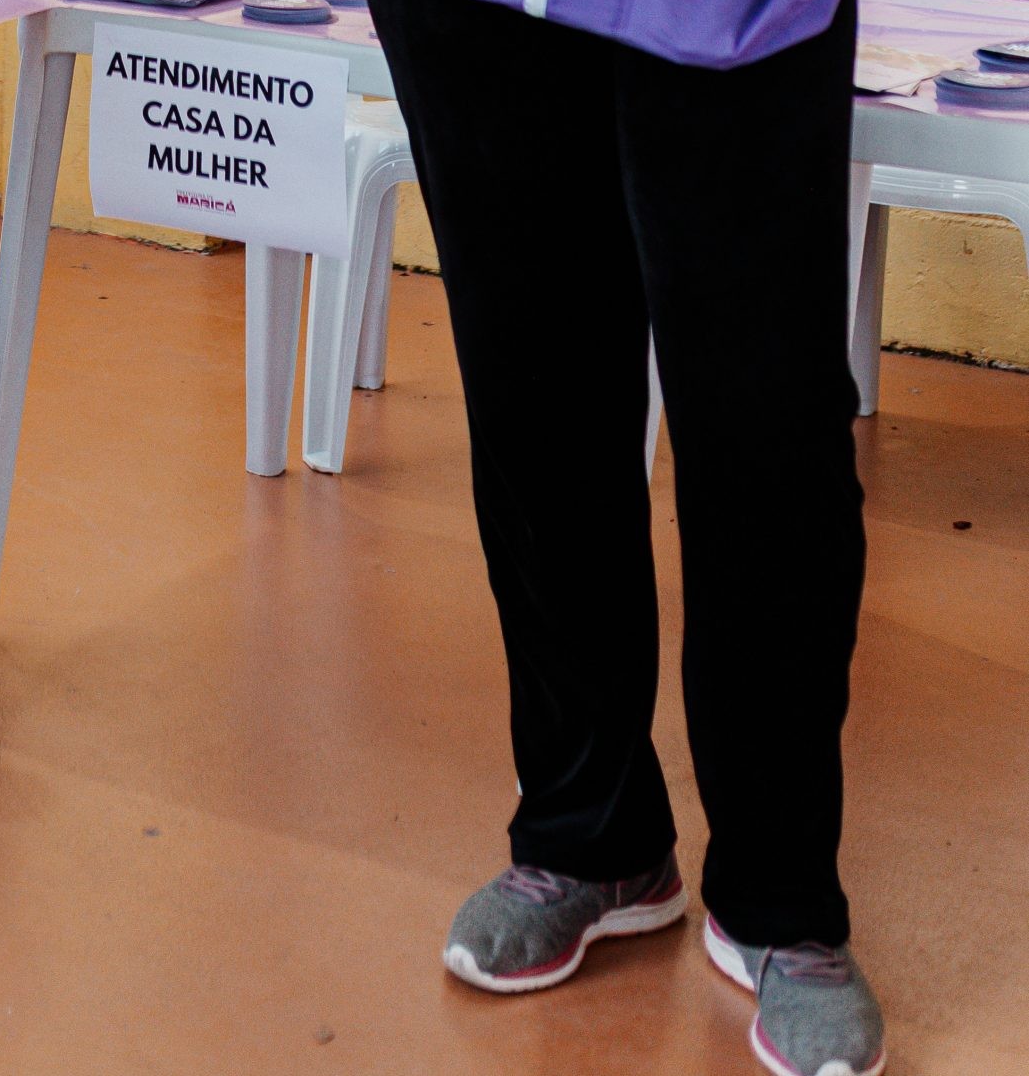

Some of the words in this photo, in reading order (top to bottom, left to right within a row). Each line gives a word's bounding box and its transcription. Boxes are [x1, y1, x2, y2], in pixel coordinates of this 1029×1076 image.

[106, 51, 314, 108] ATENDIMENTO
[142, 101, 225, 138] CASA
[233, 114, 276, 147] DA
[147, 143, 269, 188] MULHER
[176, 194, 236, 213] MARICÁ
